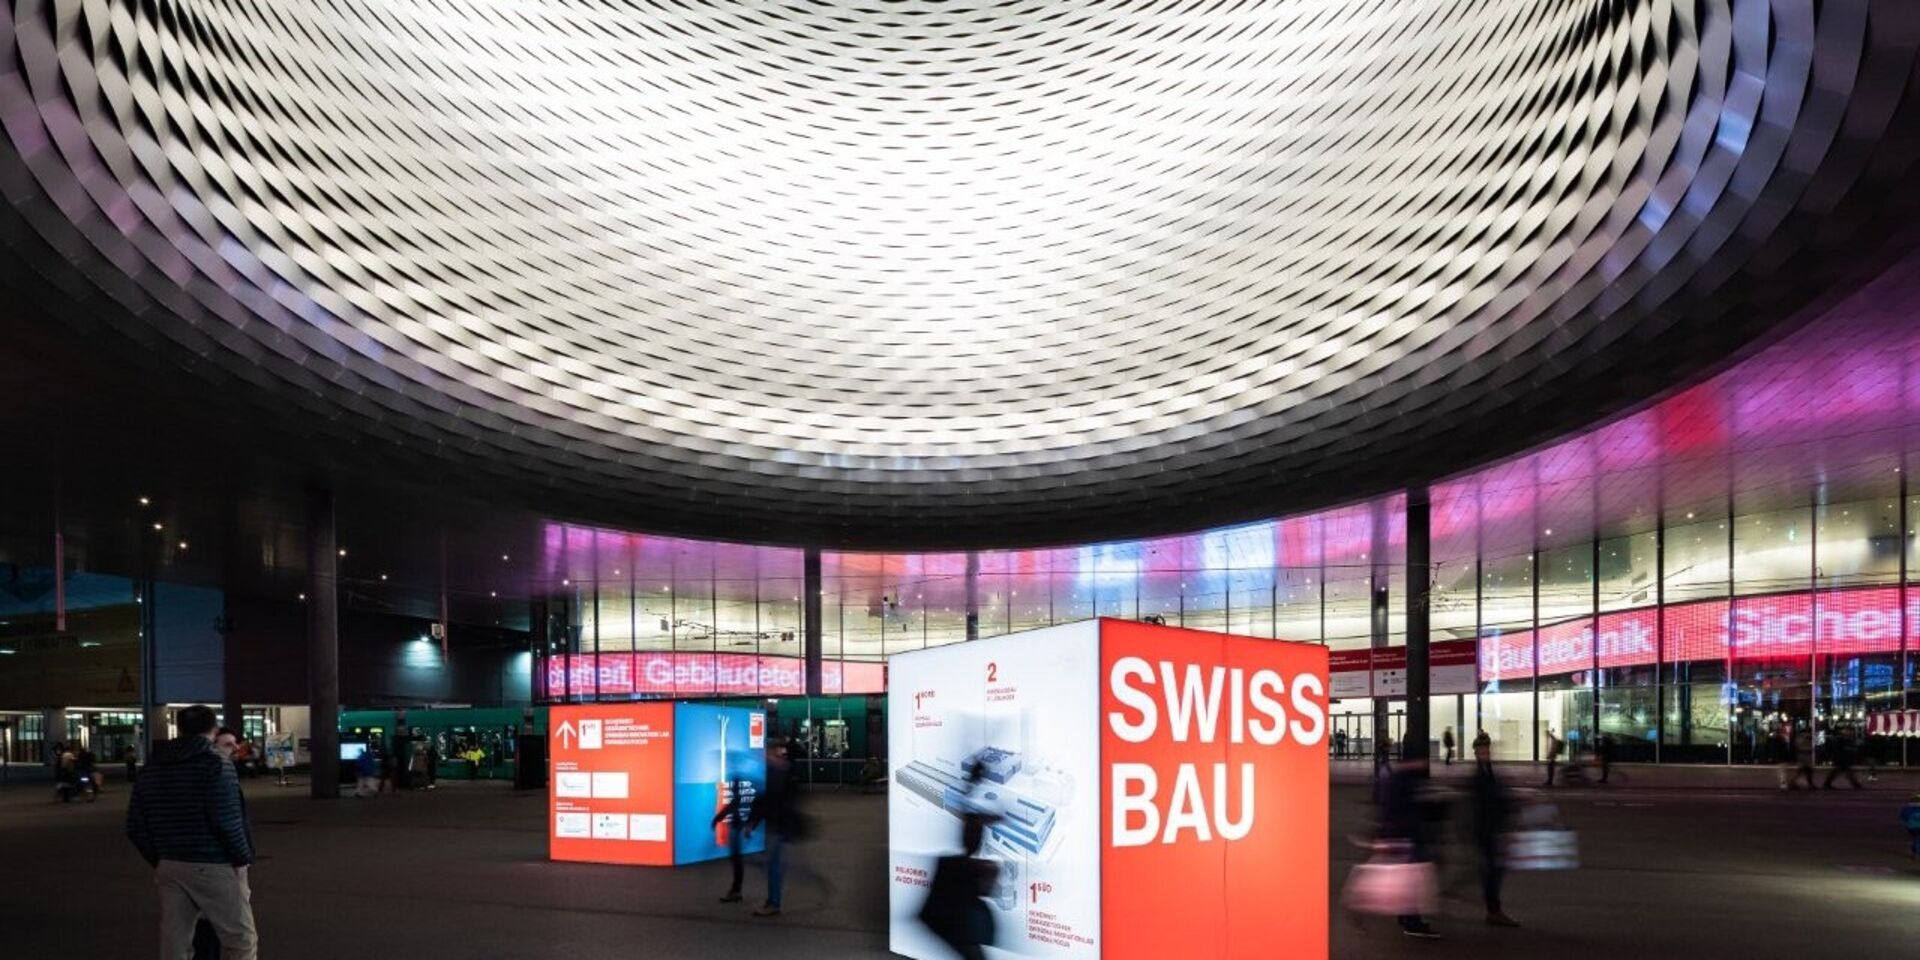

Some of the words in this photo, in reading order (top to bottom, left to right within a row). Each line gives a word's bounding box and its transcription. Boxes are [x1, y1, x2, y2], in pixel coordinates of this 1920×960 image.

[986, 662, 998, 683] 2
[1108, 656, 1326, 746] SWISS
[1112, 763, 1255, 848] BAU
[1029, 882, 1036, 904] 1
